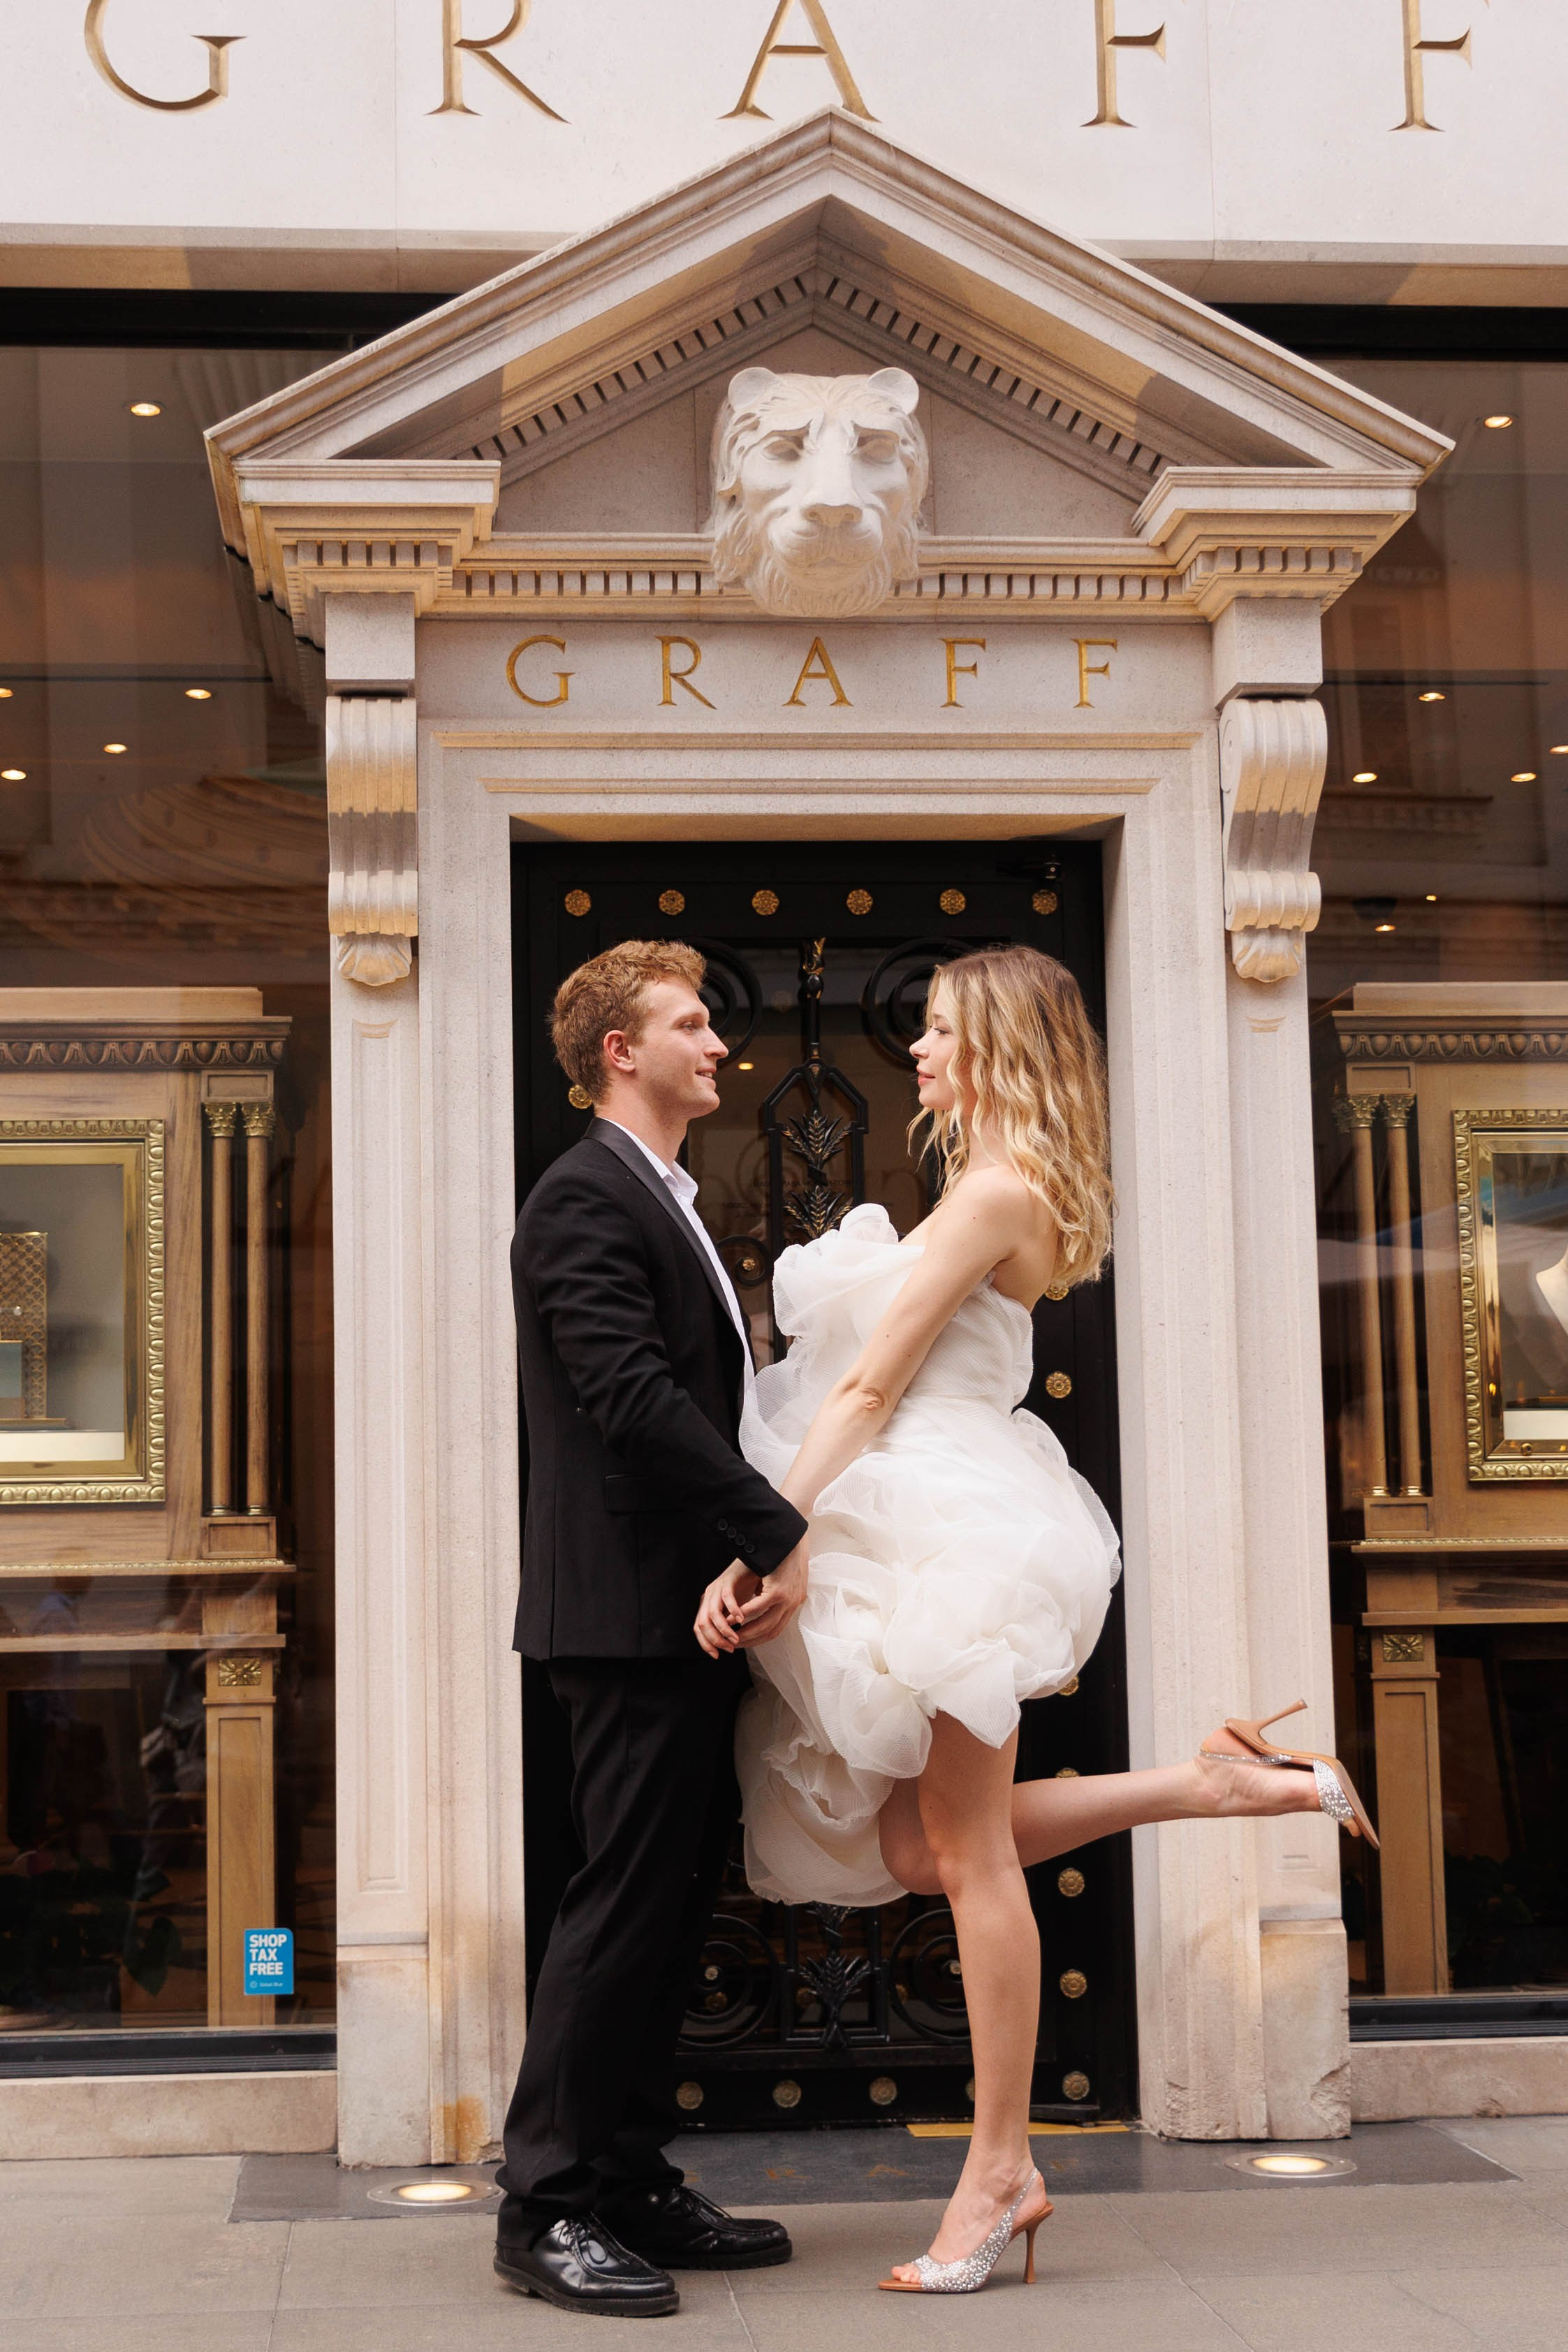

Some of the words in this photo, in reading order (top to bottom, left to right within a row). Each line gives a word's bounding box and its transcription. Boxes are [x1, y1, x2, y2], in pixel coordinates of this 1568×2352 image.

[84, 0, 1490, 132] GRAFF
[506, 634, 1118, 710] GRAFF
[249, 1934, 287, 1948] SHOP
[249, 1948, 277, 1962] TAX
[249, 1962, 284, 1975] FREE
